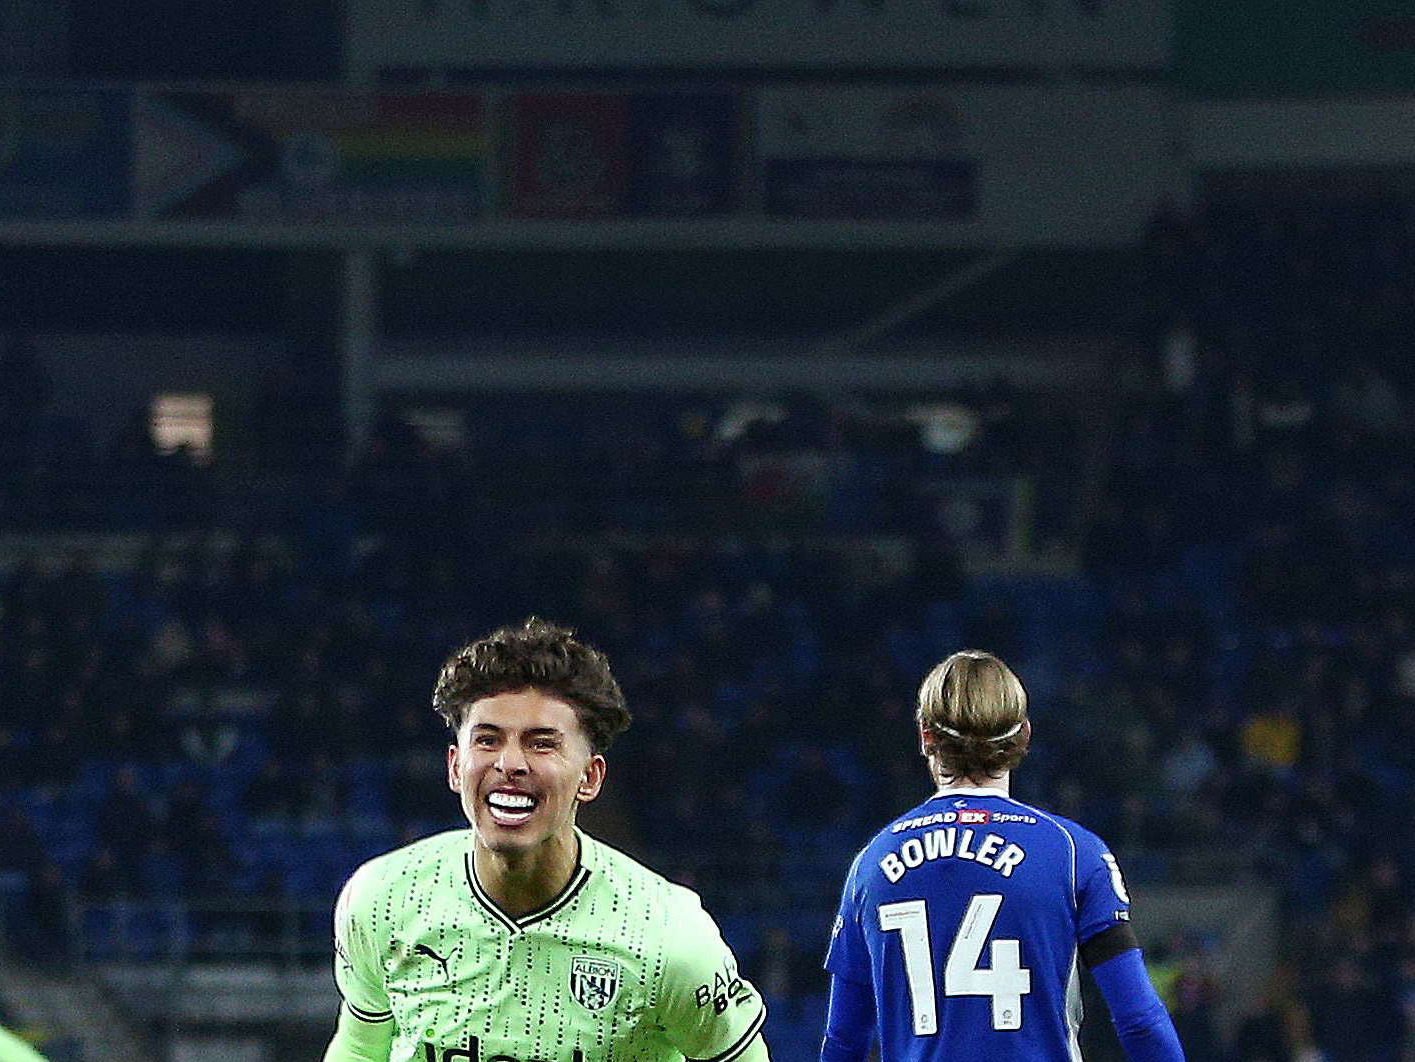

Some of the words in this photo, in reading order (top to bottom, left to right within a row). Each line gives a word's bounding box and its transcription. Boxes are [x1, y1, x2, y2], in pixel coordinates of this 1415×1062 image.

[993, 812, 1037, 824] Sports
[879, 827, 1026, 884] BOWLER
[878, 894, 1032, 1036] 14
